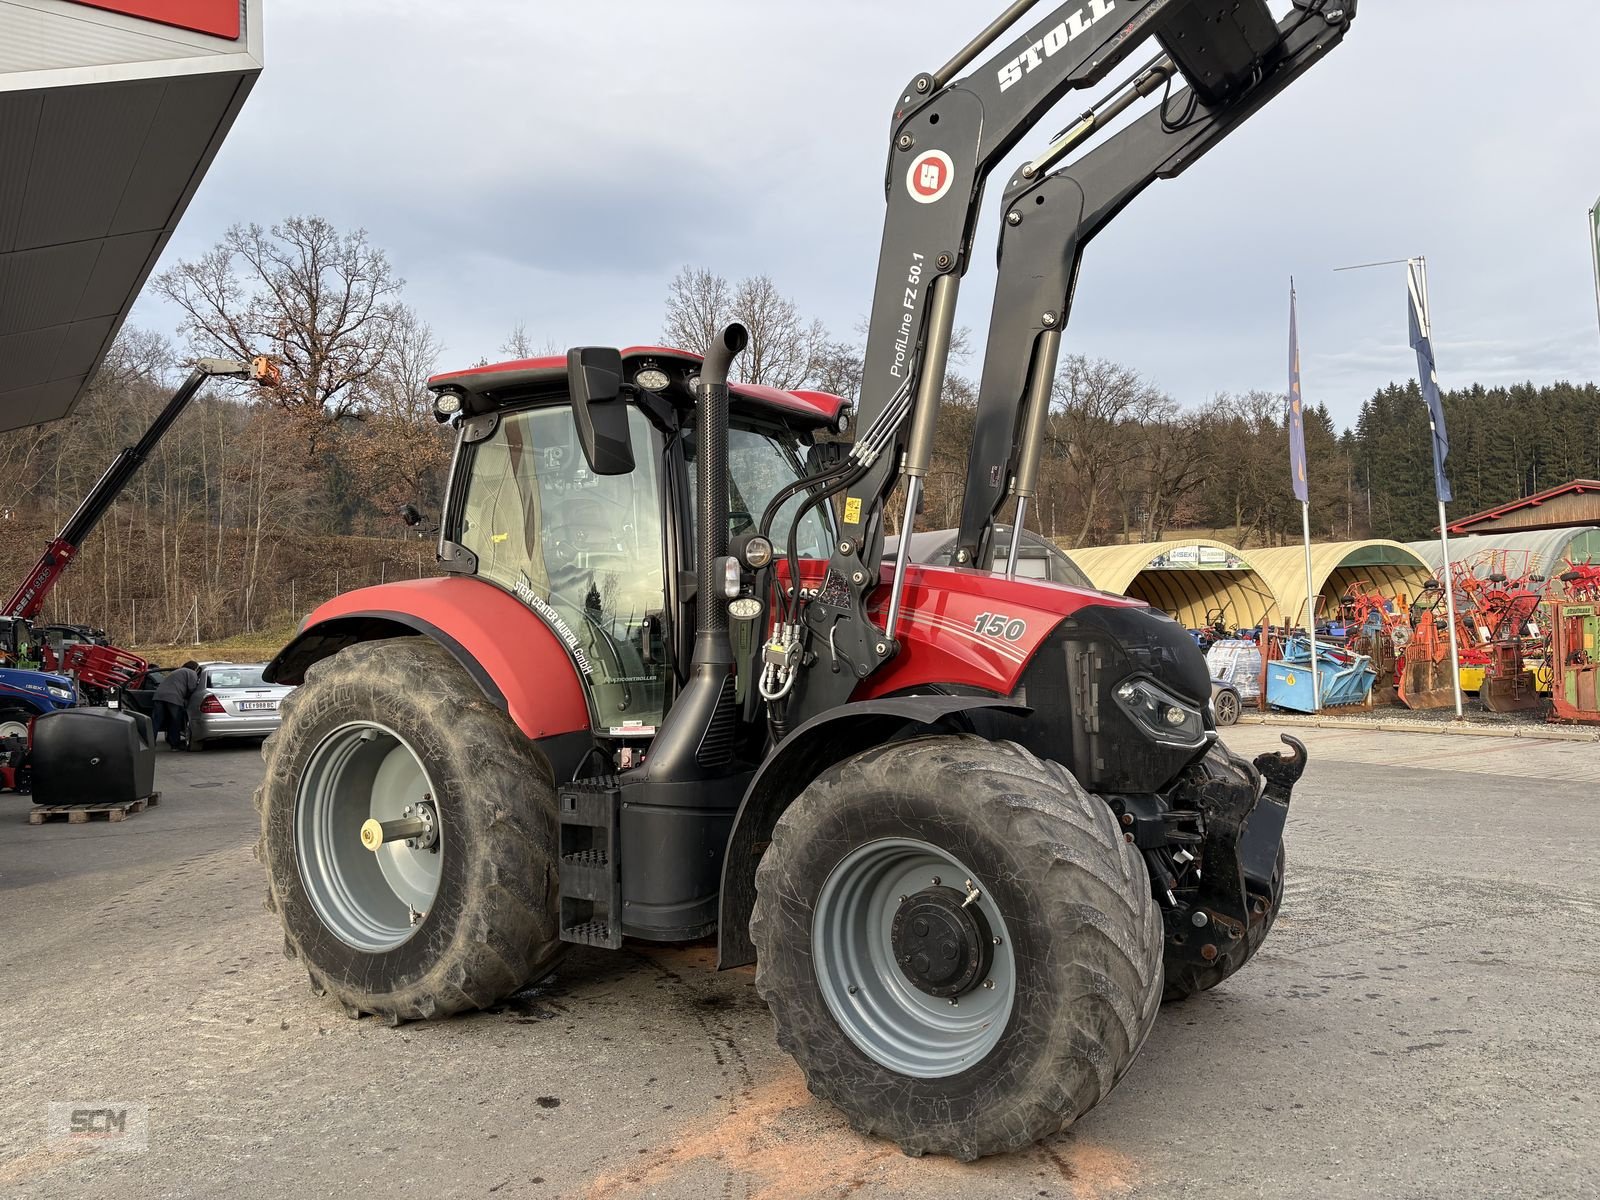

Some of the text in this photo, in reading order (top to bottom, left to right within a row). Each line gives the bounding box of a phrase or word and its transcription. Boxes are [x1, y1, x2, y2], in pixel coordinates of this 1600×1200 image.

[997, 0, 1116, 93] STOLL
[890, 252, 924, 377] ProfiLine FZ 50.1
[34, 566, 51, 588] 935
[513, 581, 594, 675] STEYR CENTER MURTAL GmbH
[974, 612, 1027, 642] 150
